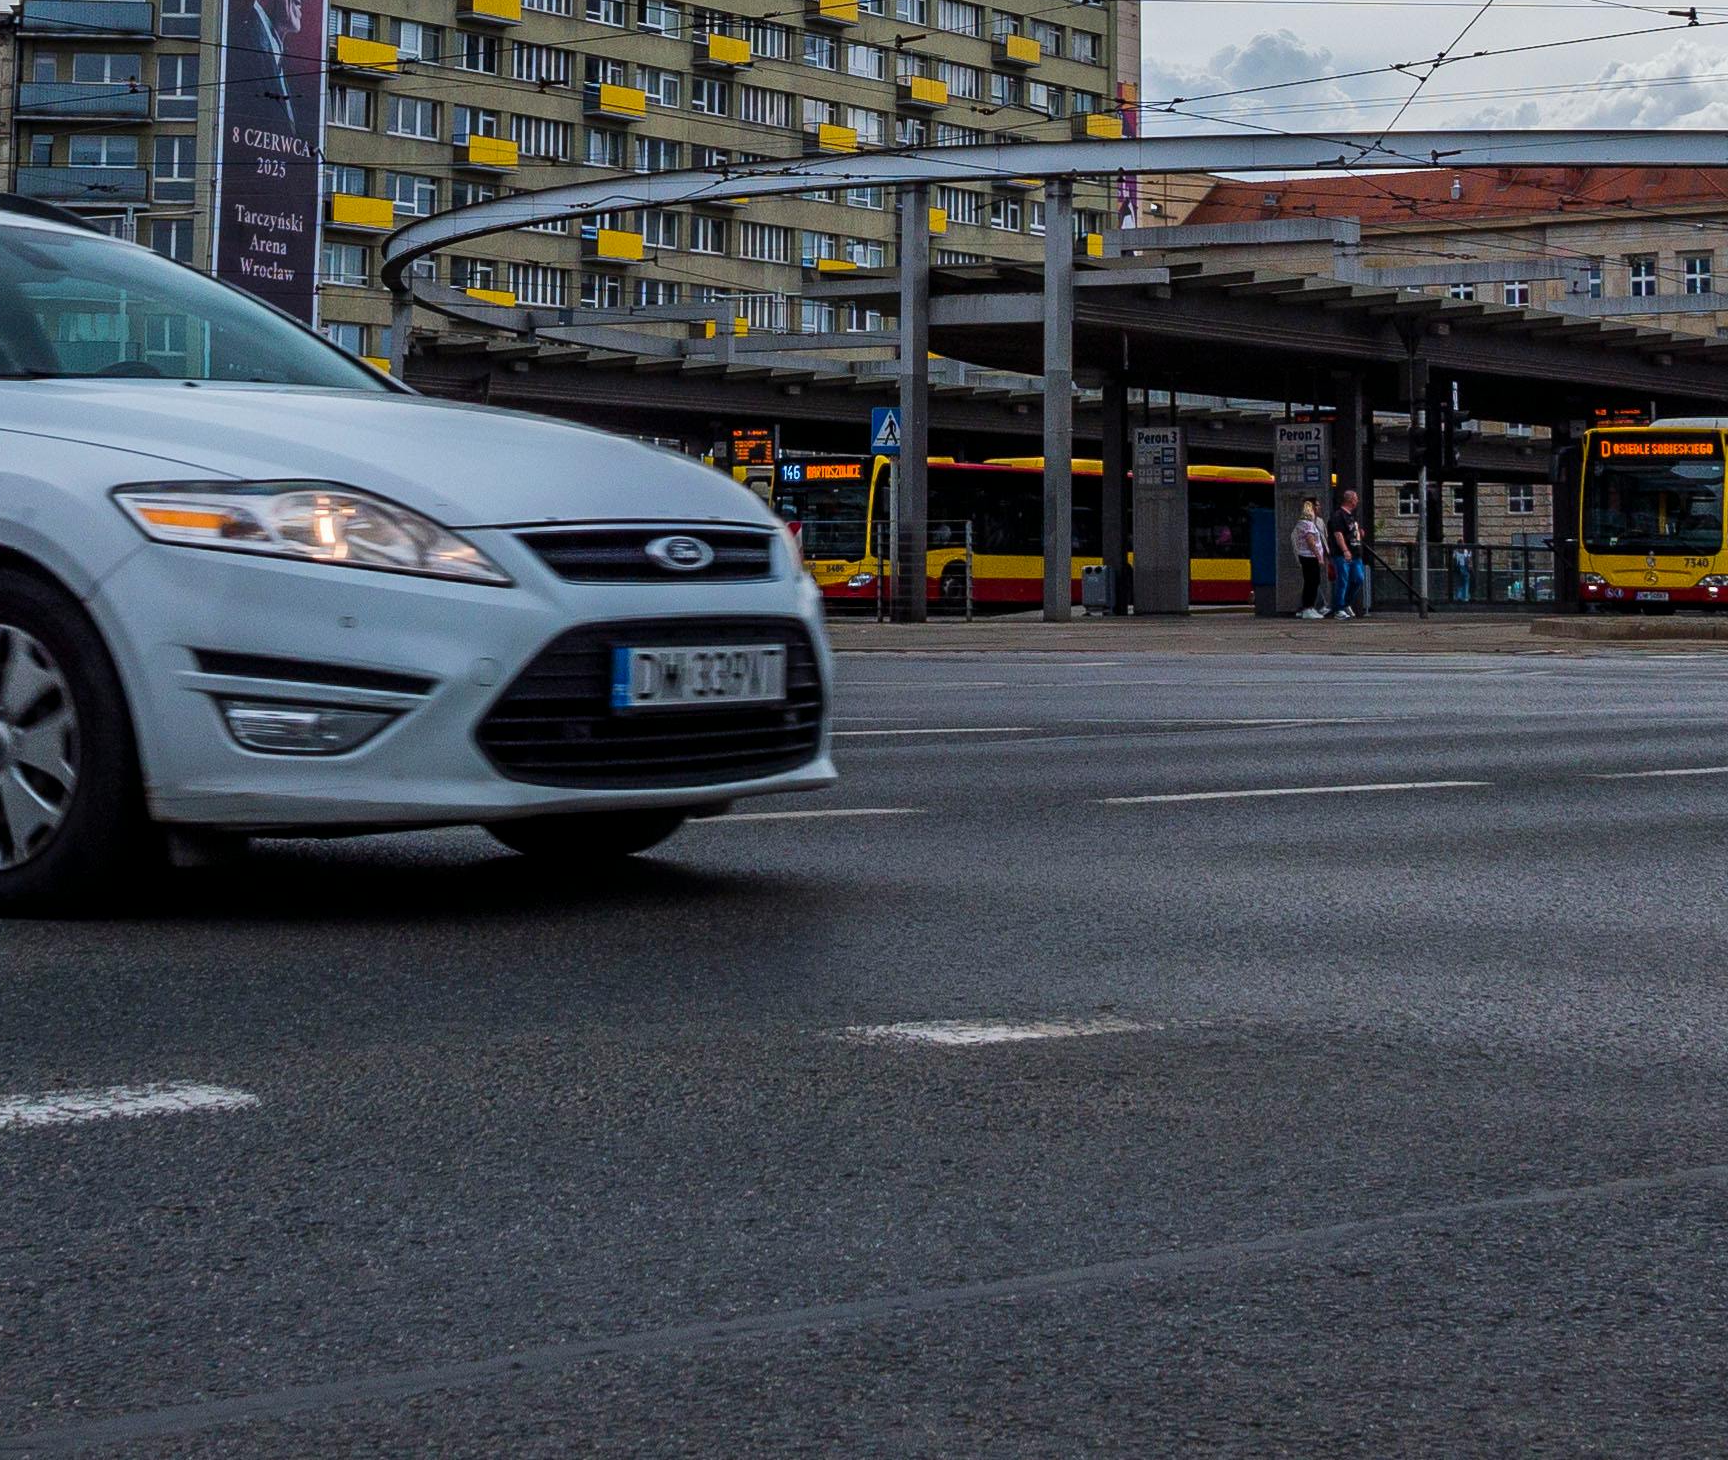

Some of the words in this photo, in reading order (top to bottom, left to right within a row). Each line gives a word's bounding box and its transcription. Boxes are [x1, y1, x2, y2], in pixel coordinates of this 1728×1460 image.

[232, 126, 240, 143] 8
[244, 128, 312, 158] CZERWCA
[256, 157, 287, 179] 2025
[235, 204, 303, 233] Tarczyński
[249, 234, 287, 255] Arena
[240, 257, 295, 282] Wrocław
[1137, 432, 1169, 444] Peron
[1170, 431, 1177, 444] 3
[1280, 429, 1312, 441] Peron
[1314, 428, 1321, 440] 2
[1601, 441, 1611, 458] D
[1613, 443, 1650, 455] OSIEDLE
[1651, 443, 1714, 455] SOBIESKIEGO
[782, 464, 801, 481] 146
